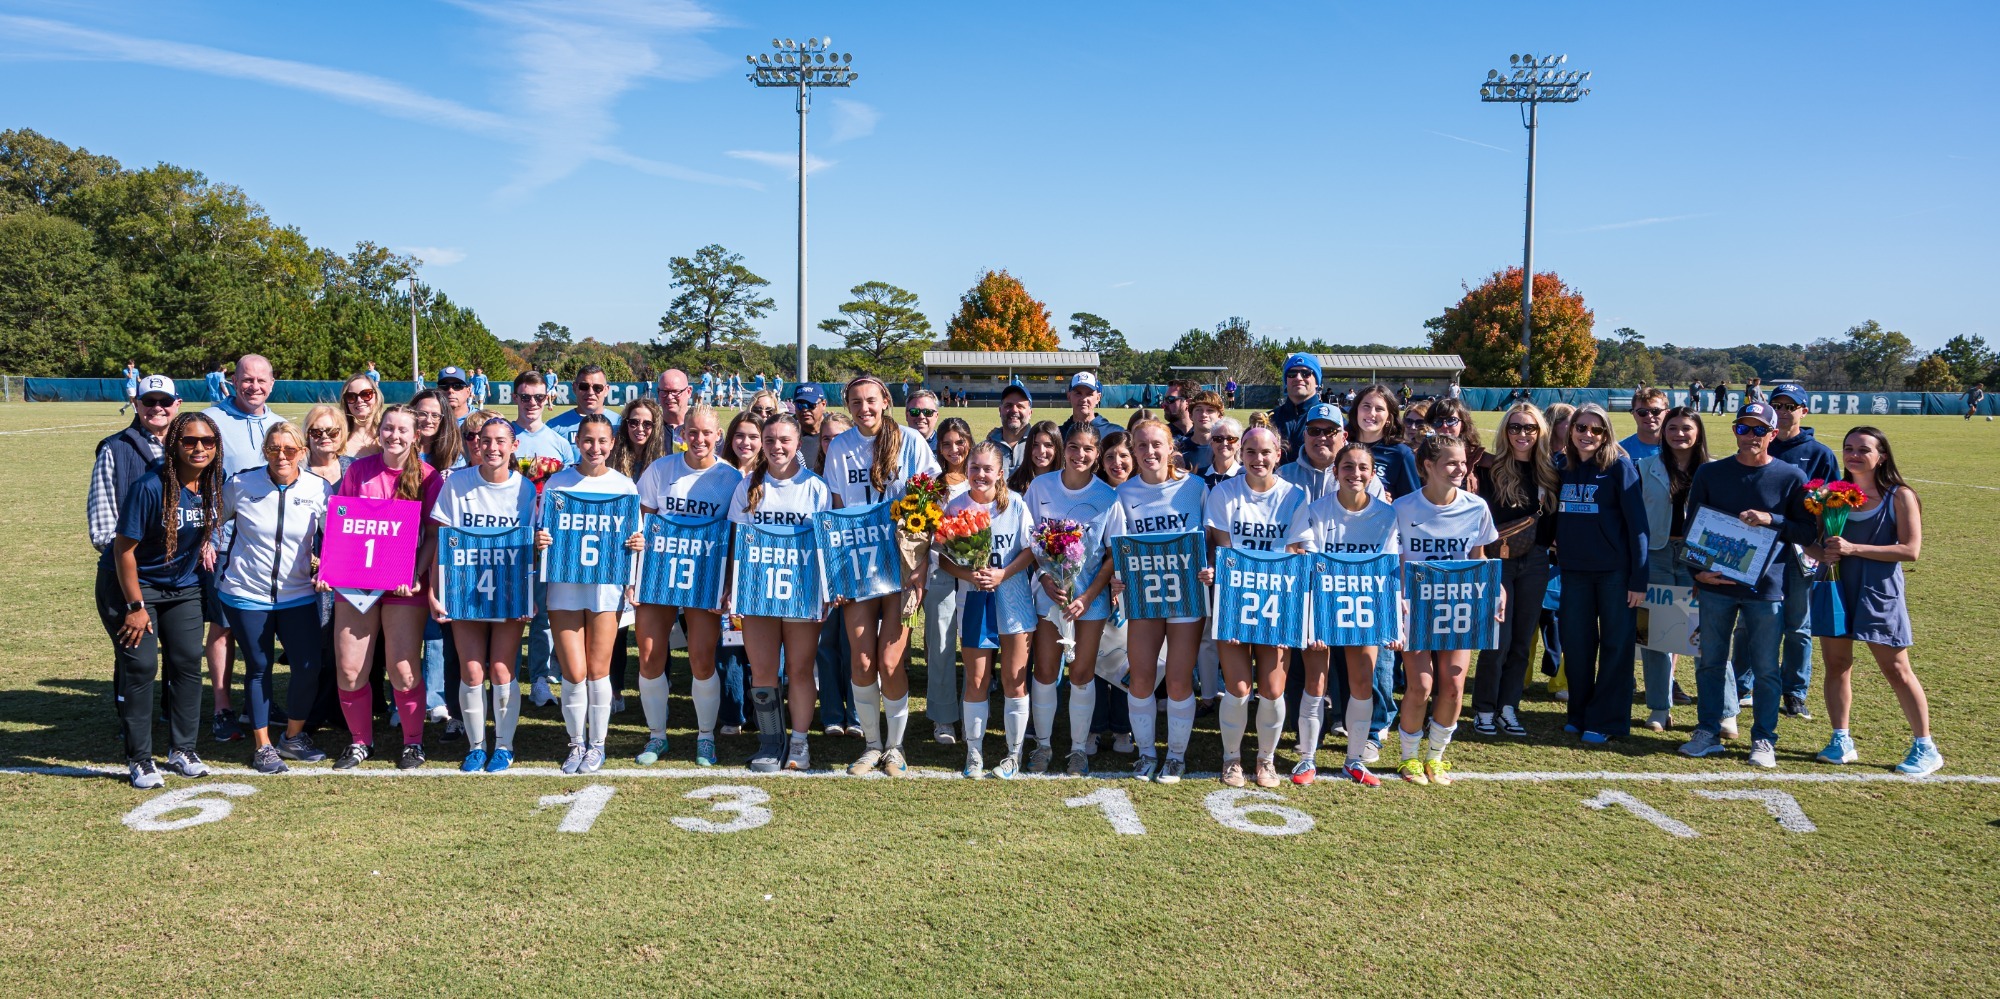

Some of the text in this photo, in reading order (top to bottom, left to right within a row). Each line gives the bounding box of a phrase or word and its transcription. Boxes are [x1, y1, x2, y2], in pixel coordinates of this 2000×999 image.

[666, 496, 721, 517] BERRY
[342, 518, 403, 537] BERRY
[464, 513, 521, 527] BERRY
[558, 513, 625, 533] BERRY
[754, 511, 808, 525] BERRY
[1135, 512, 1190, 533] BERRY
[828, 524, 892, 548] BERRY
[1233, 520, 1288, 539] BERRY
[364, 538, 376, 568] 1
[580, 534, 600, 567] 6
[653, 536, 715, 557] BERRY
[1410, 537, 1470, 553] BERRY
[453, 549, 519, 566] BERRY
[748, 546, 813, 566] BERRY
[849, 546, 879, 580] 17
[1128, 553, 1191, 572] BERRY
[668, 557, 695, 590] 13
[765, 567, 793, 600] 16
[1229, 570, 1296, 593] BERRY
[1321, 575, 1387, 593] BERRY
[476, 569, 497, 601] 4
[1143, 573, 1182, 603] 23
[1420, 582, 1487, 600] BERRY
[1240, 592, 1281, 628] 24
[1337, 595, 1375, 628] 26
[1433, 603, 1472, 634] 28
[122, 782, 259, 831] 6
